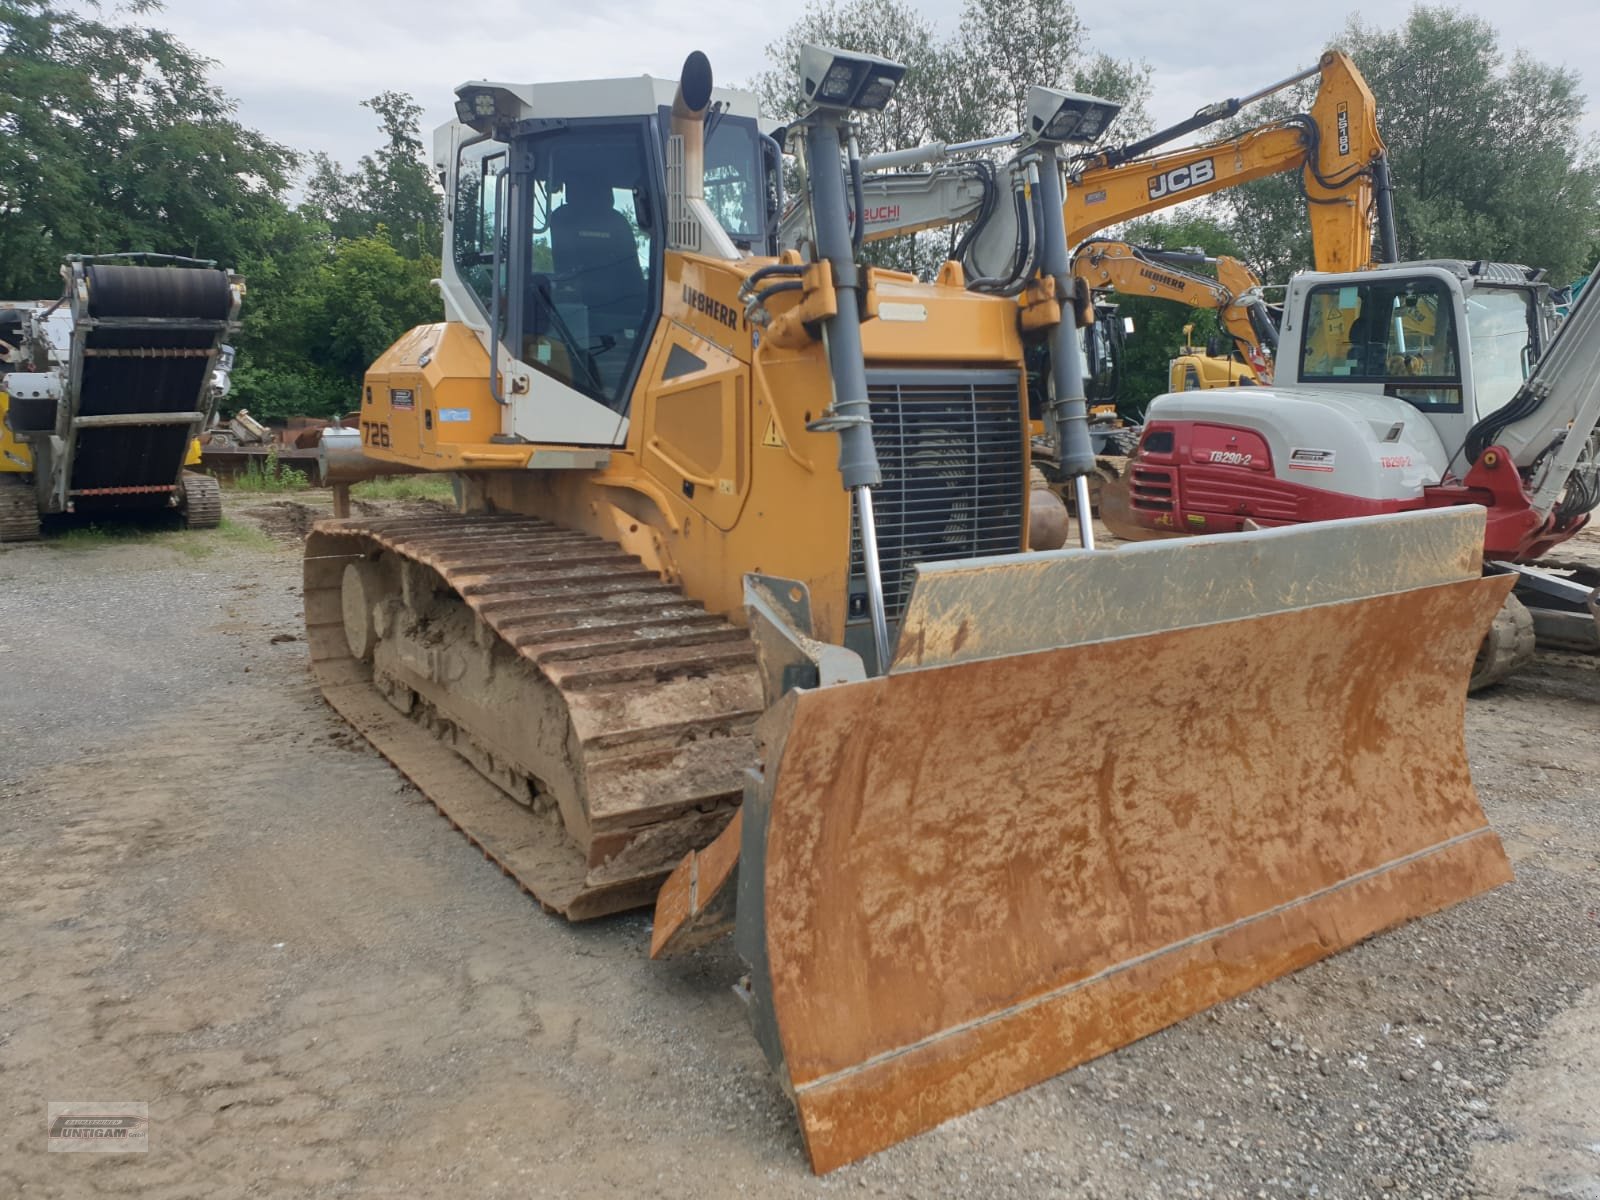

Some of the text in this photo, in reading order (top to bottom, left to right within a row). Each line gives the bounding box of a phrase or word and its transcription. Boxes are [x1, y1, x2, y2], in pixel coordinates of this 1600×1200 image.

[1149, 159, 1215, 198] JCB
[1140, 268, 1185, 290] LIEBHERR
[682, 283, 738, 331] LIEBHERR
[362, 421, 389, 448] 726
[1209, 451, 1252, 465] TB290-2
